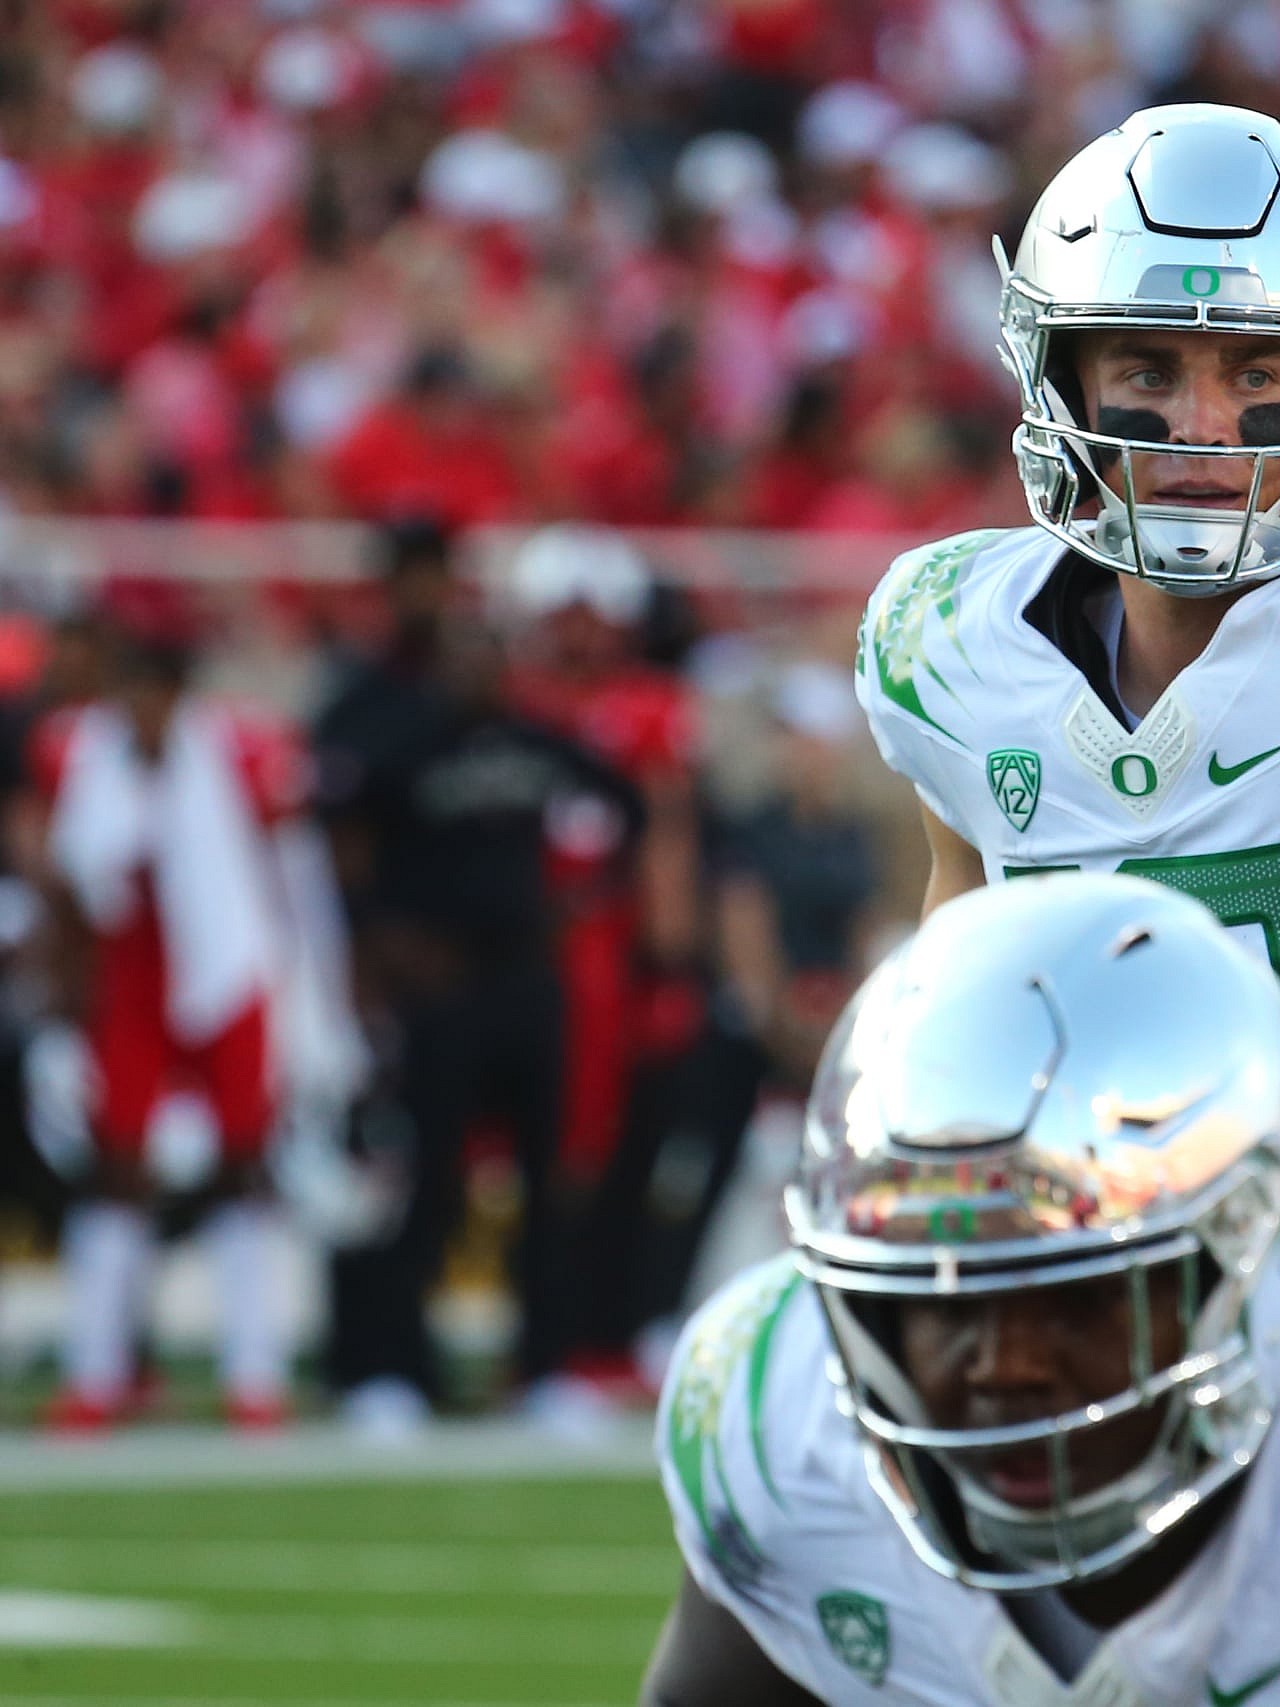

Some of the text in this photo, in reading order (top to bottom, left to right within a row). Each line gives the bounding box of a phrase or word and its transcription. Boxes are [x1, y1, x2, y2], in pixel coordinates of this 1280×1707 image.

[1182, 266, 1221, 297] O
[1111, 754, 1158, 797] O
[1003, 787, 1030, 815] 12
[927, 1202, 977, 1244] O
